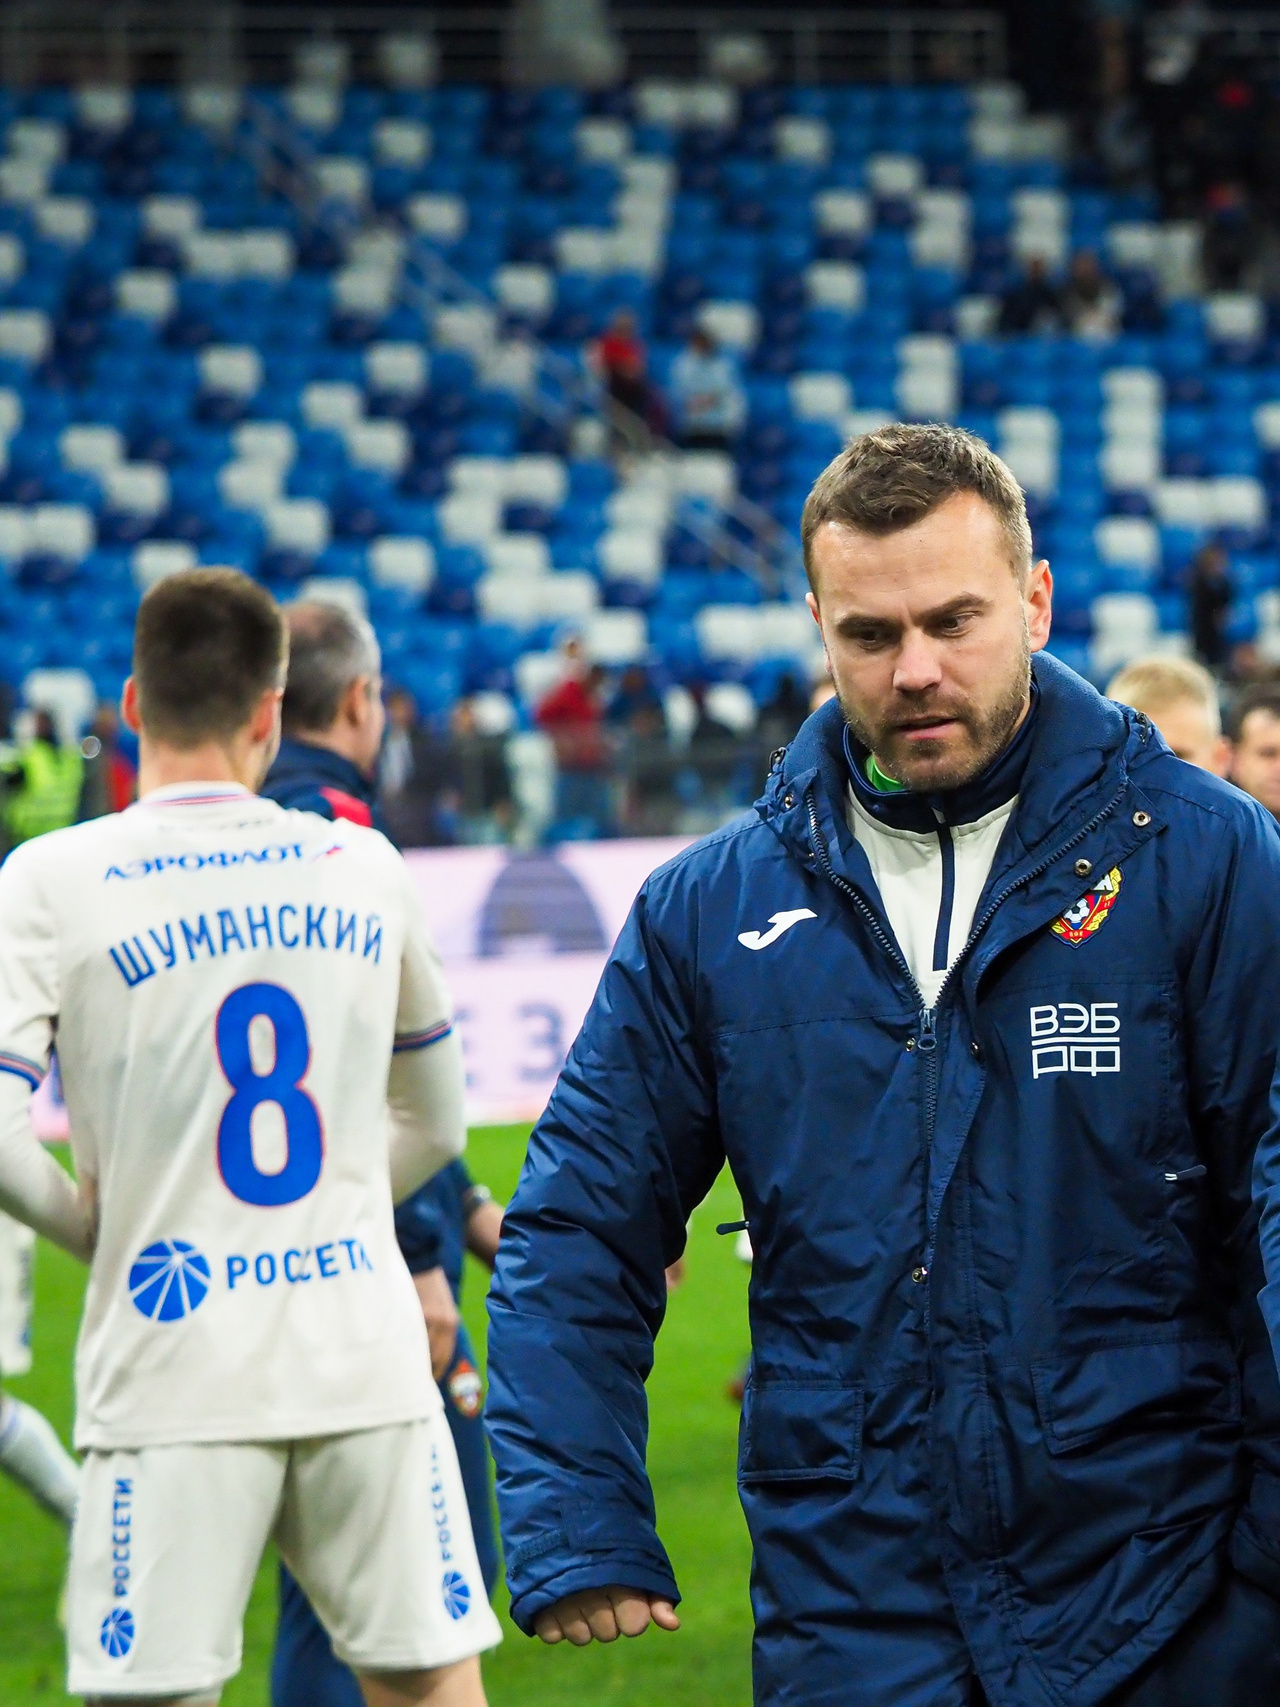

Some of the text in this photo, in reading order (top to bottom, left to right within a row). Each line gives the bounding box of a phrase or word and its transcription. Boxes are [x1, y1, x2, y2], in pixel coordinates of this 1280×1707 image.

[104, 843, 303, 881] АЭРОФЛОТ
[109, 903, 383, 988] ШУМАНСКИЙ
[1030, 1003, 1121, 1037] ВЭБ
[1032, 1046, 1121, 1080] РФ
[215, 981, 326, 1208] 8
[226, 1238, 373, 1290] РОСЕТ
[112, 1478, 133, 1598] РОССЕТИ
